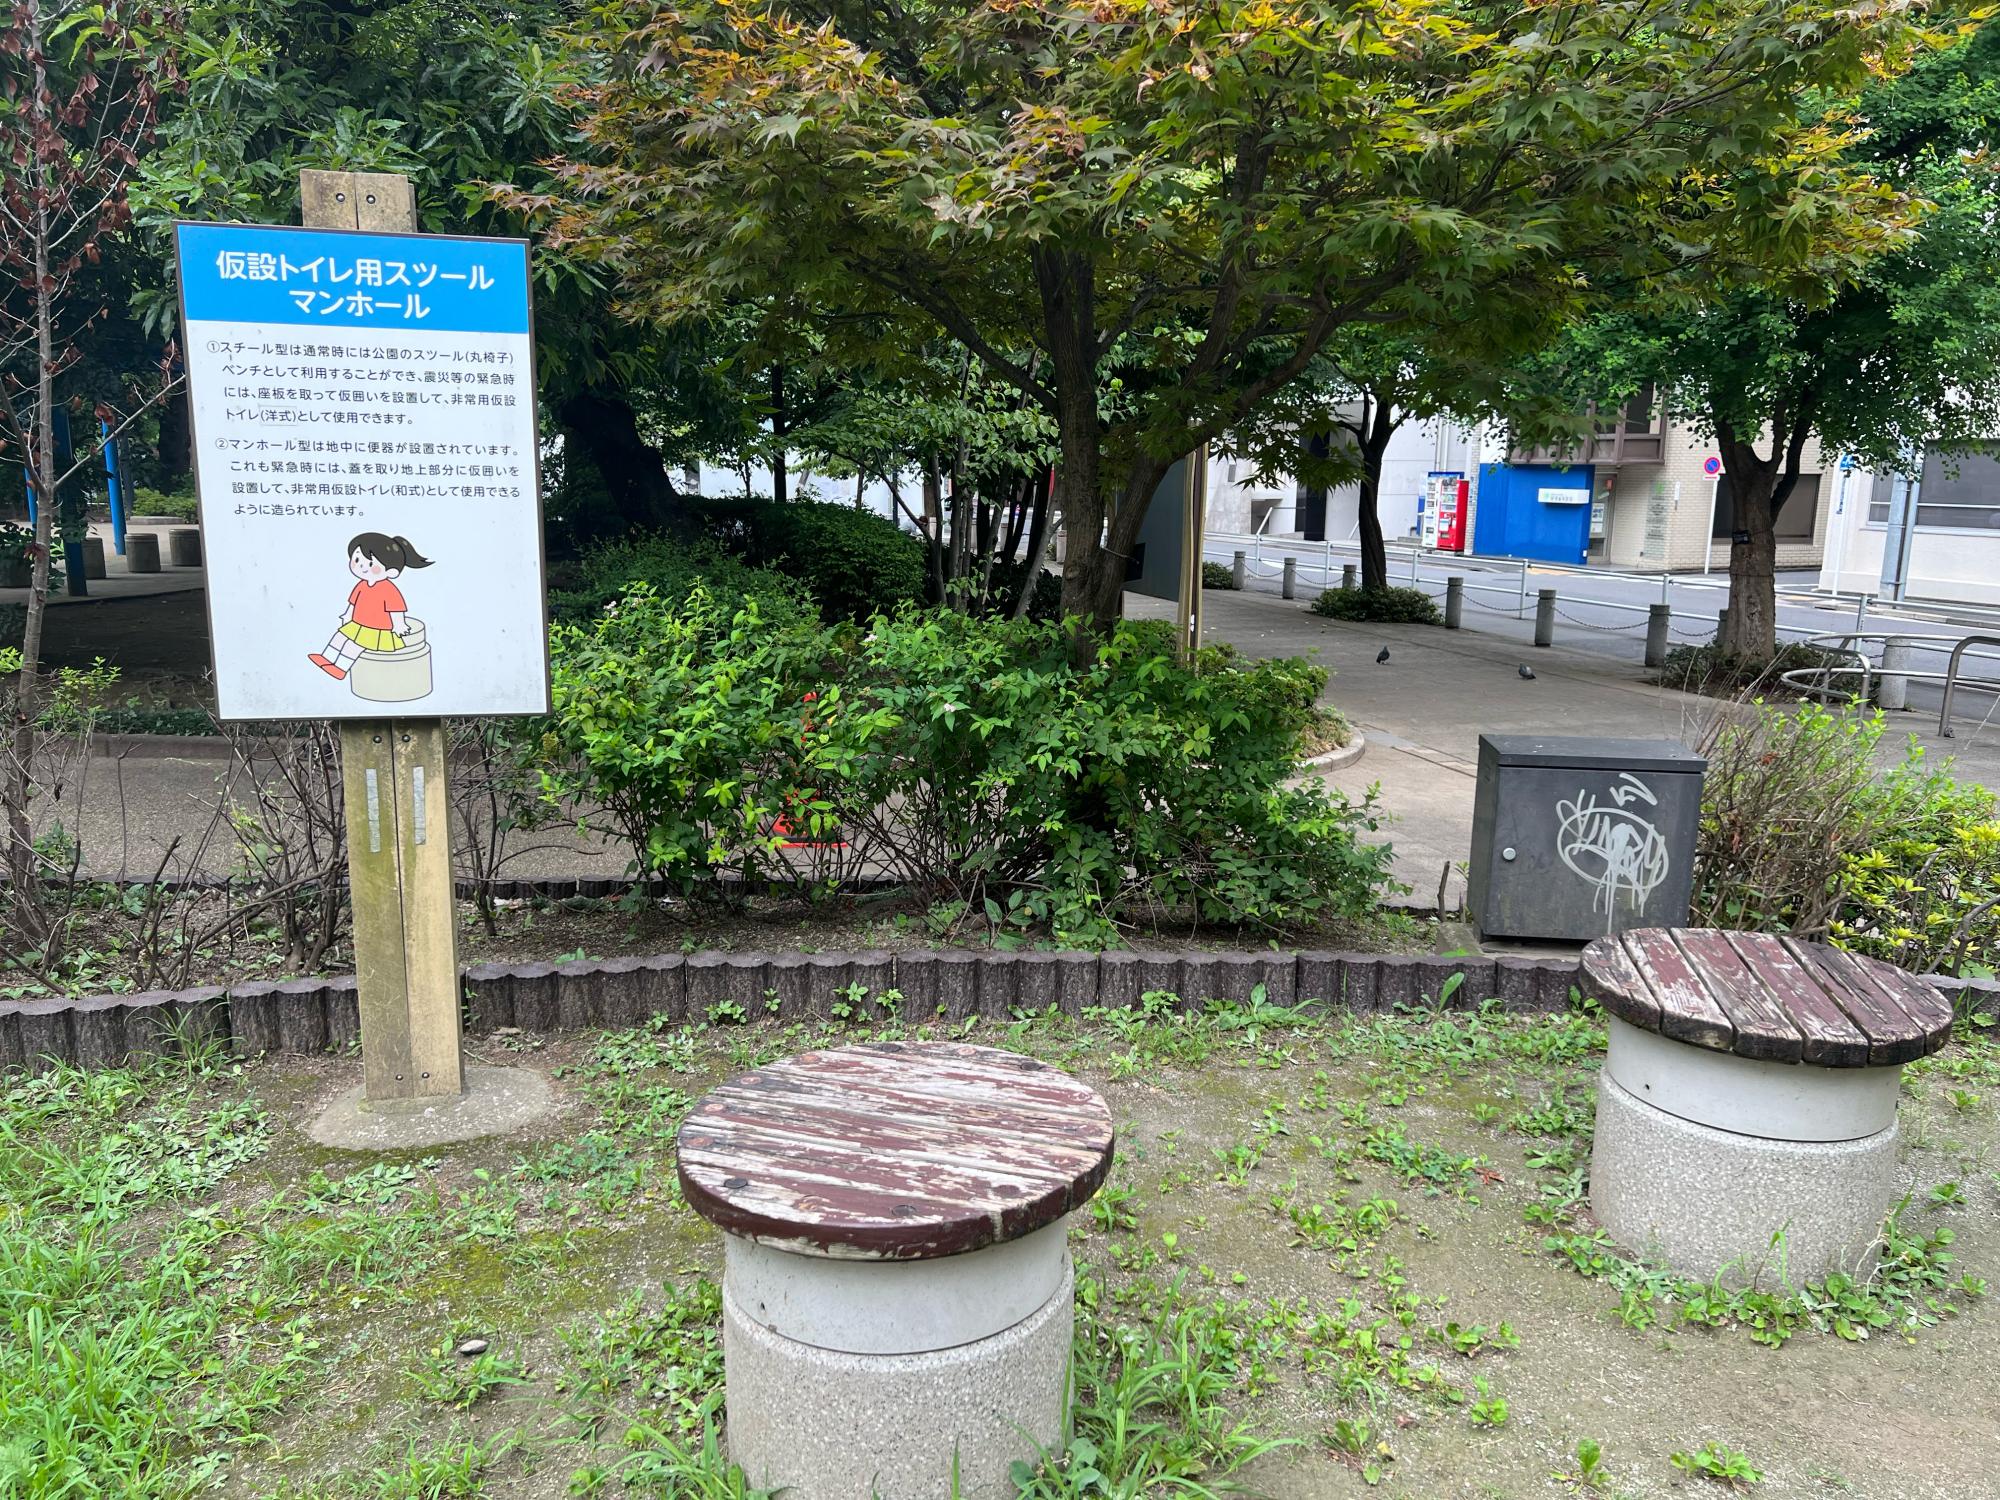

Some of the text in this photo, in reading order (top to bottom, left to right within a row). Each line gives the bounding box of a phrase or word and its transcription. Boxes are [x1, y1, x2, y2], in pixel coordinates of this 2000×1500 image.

[216, 251, 495, 290] 仮設トイレ用スツール
[289, 290, 430, 319] マンホール
[234, 503, 364, 517] ように造られています。
